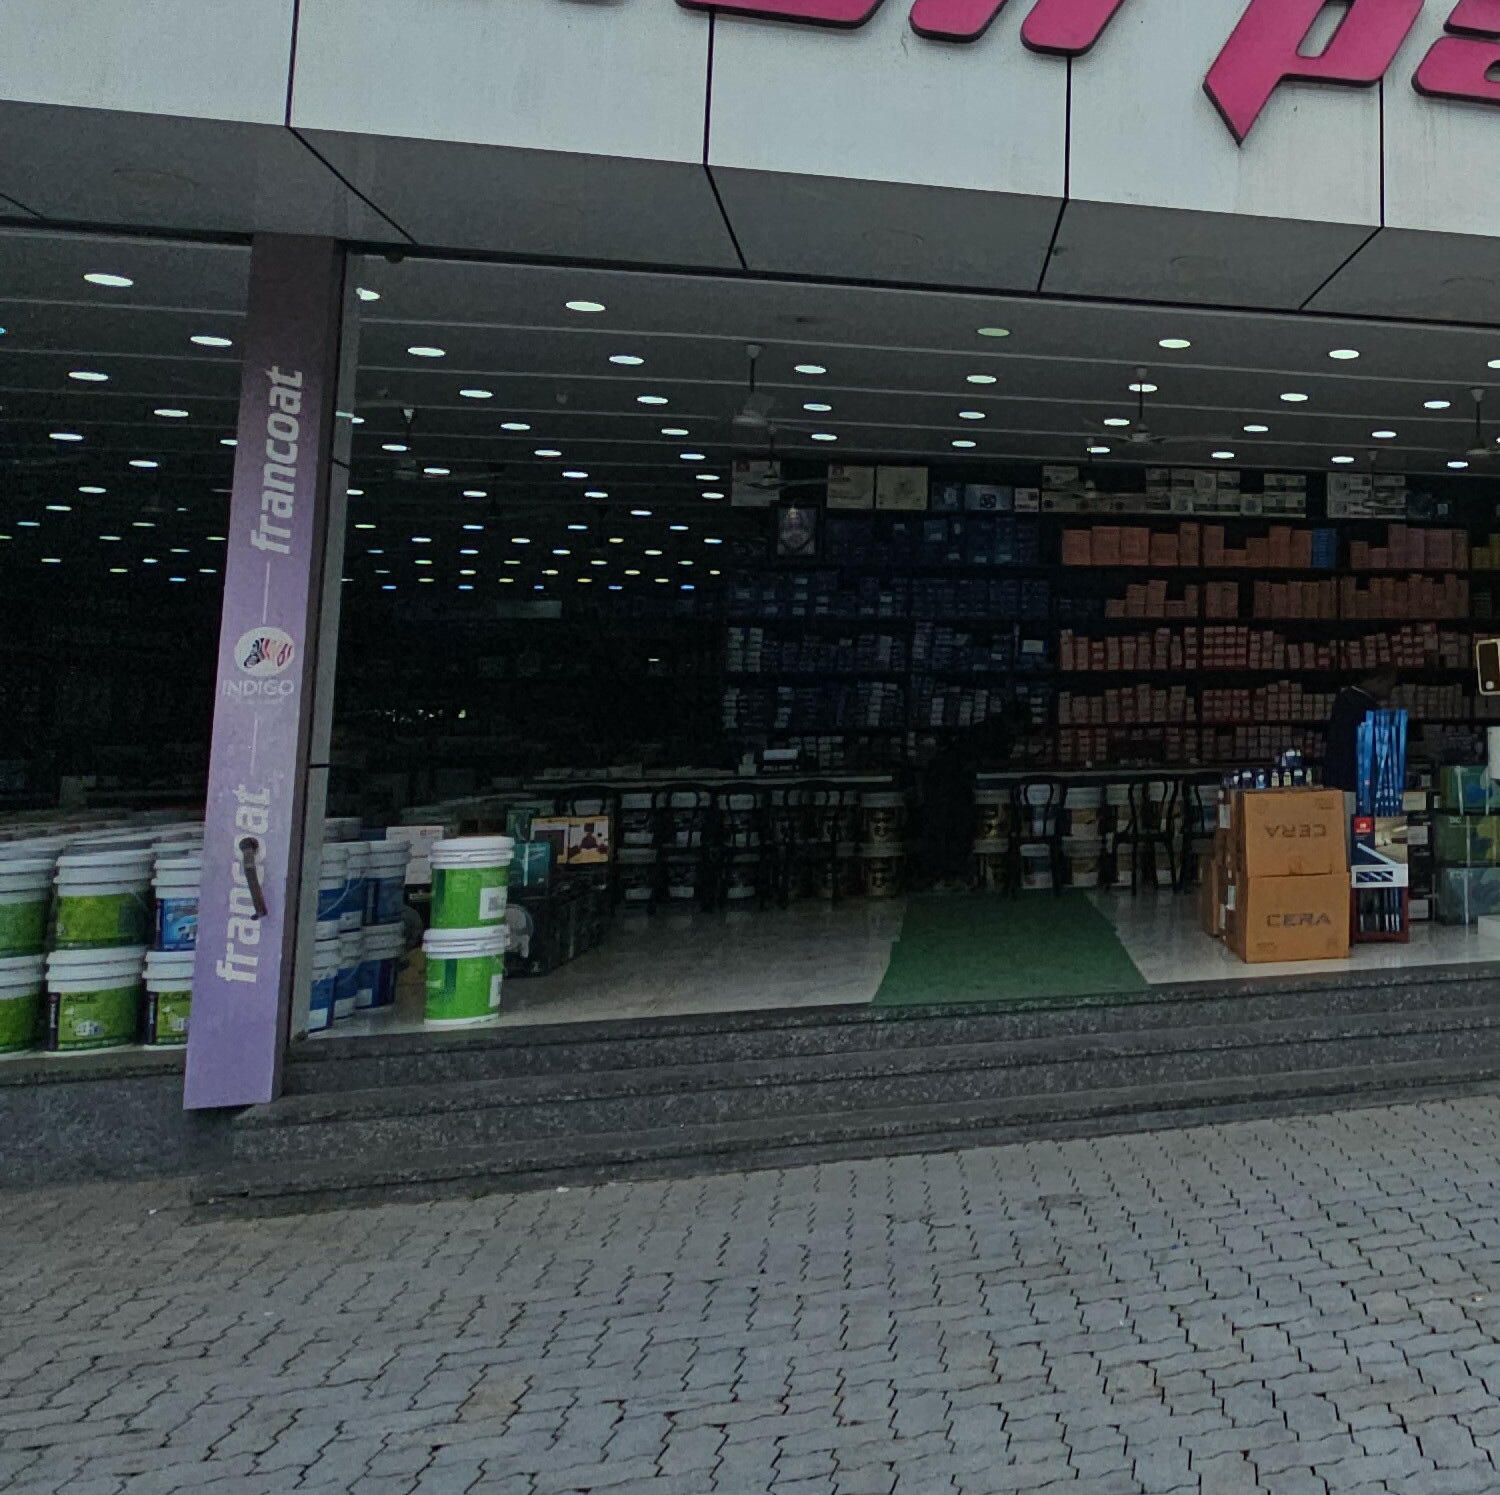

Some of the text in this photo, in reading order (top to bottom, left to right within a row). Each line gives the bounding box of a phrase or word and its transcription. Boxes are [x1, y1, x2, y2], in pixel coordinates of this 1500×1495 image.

[250, 365, 302, 554] francoat
[223, 679, 295, 696] INDIGO
[1264, 823, 1327, 838] CERA
[1266, 912, 1332, 929] CERA
